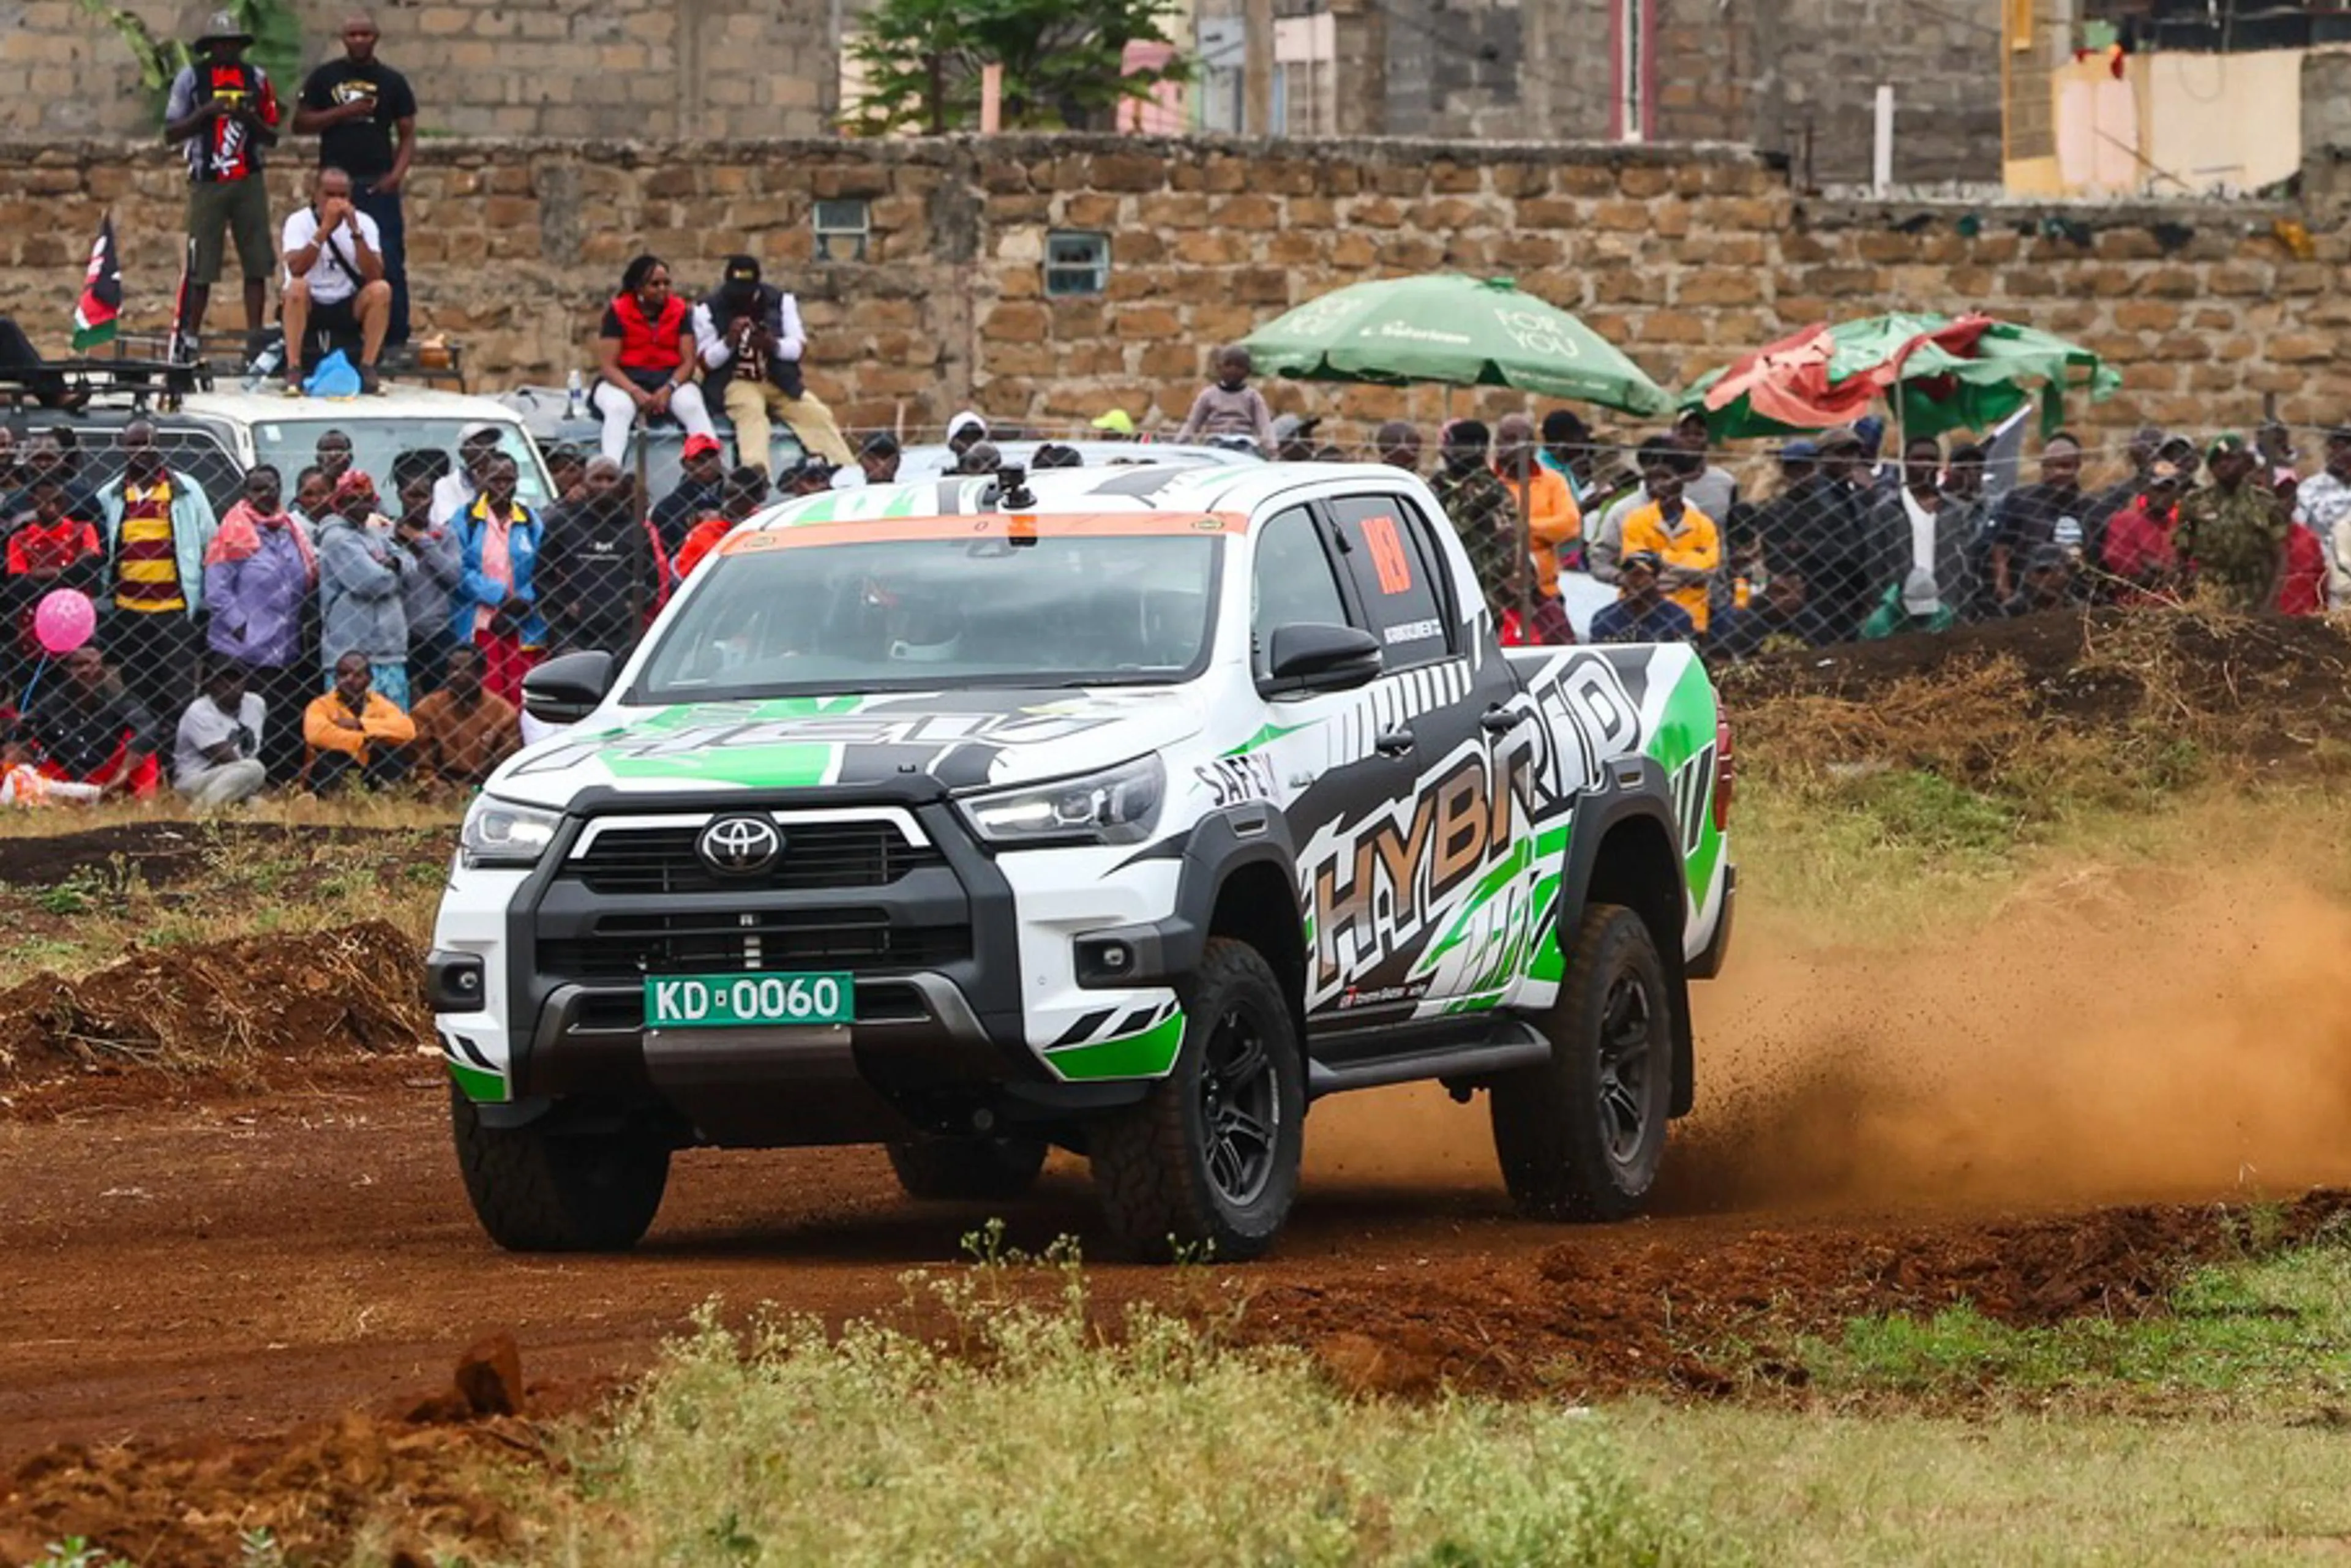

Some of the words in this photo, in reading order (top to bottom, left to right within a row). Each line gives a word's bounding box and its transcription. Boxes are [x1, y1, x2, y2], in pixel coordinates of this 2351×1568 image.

[1494, 309, 1562, 334] FOR
[1506, 329, 1580, 358] YOU
[1312, 654, 1641, 983] HYBRID
[656, 981, 708, 1019] KD
[732, 977, 839, 1019] 0060
